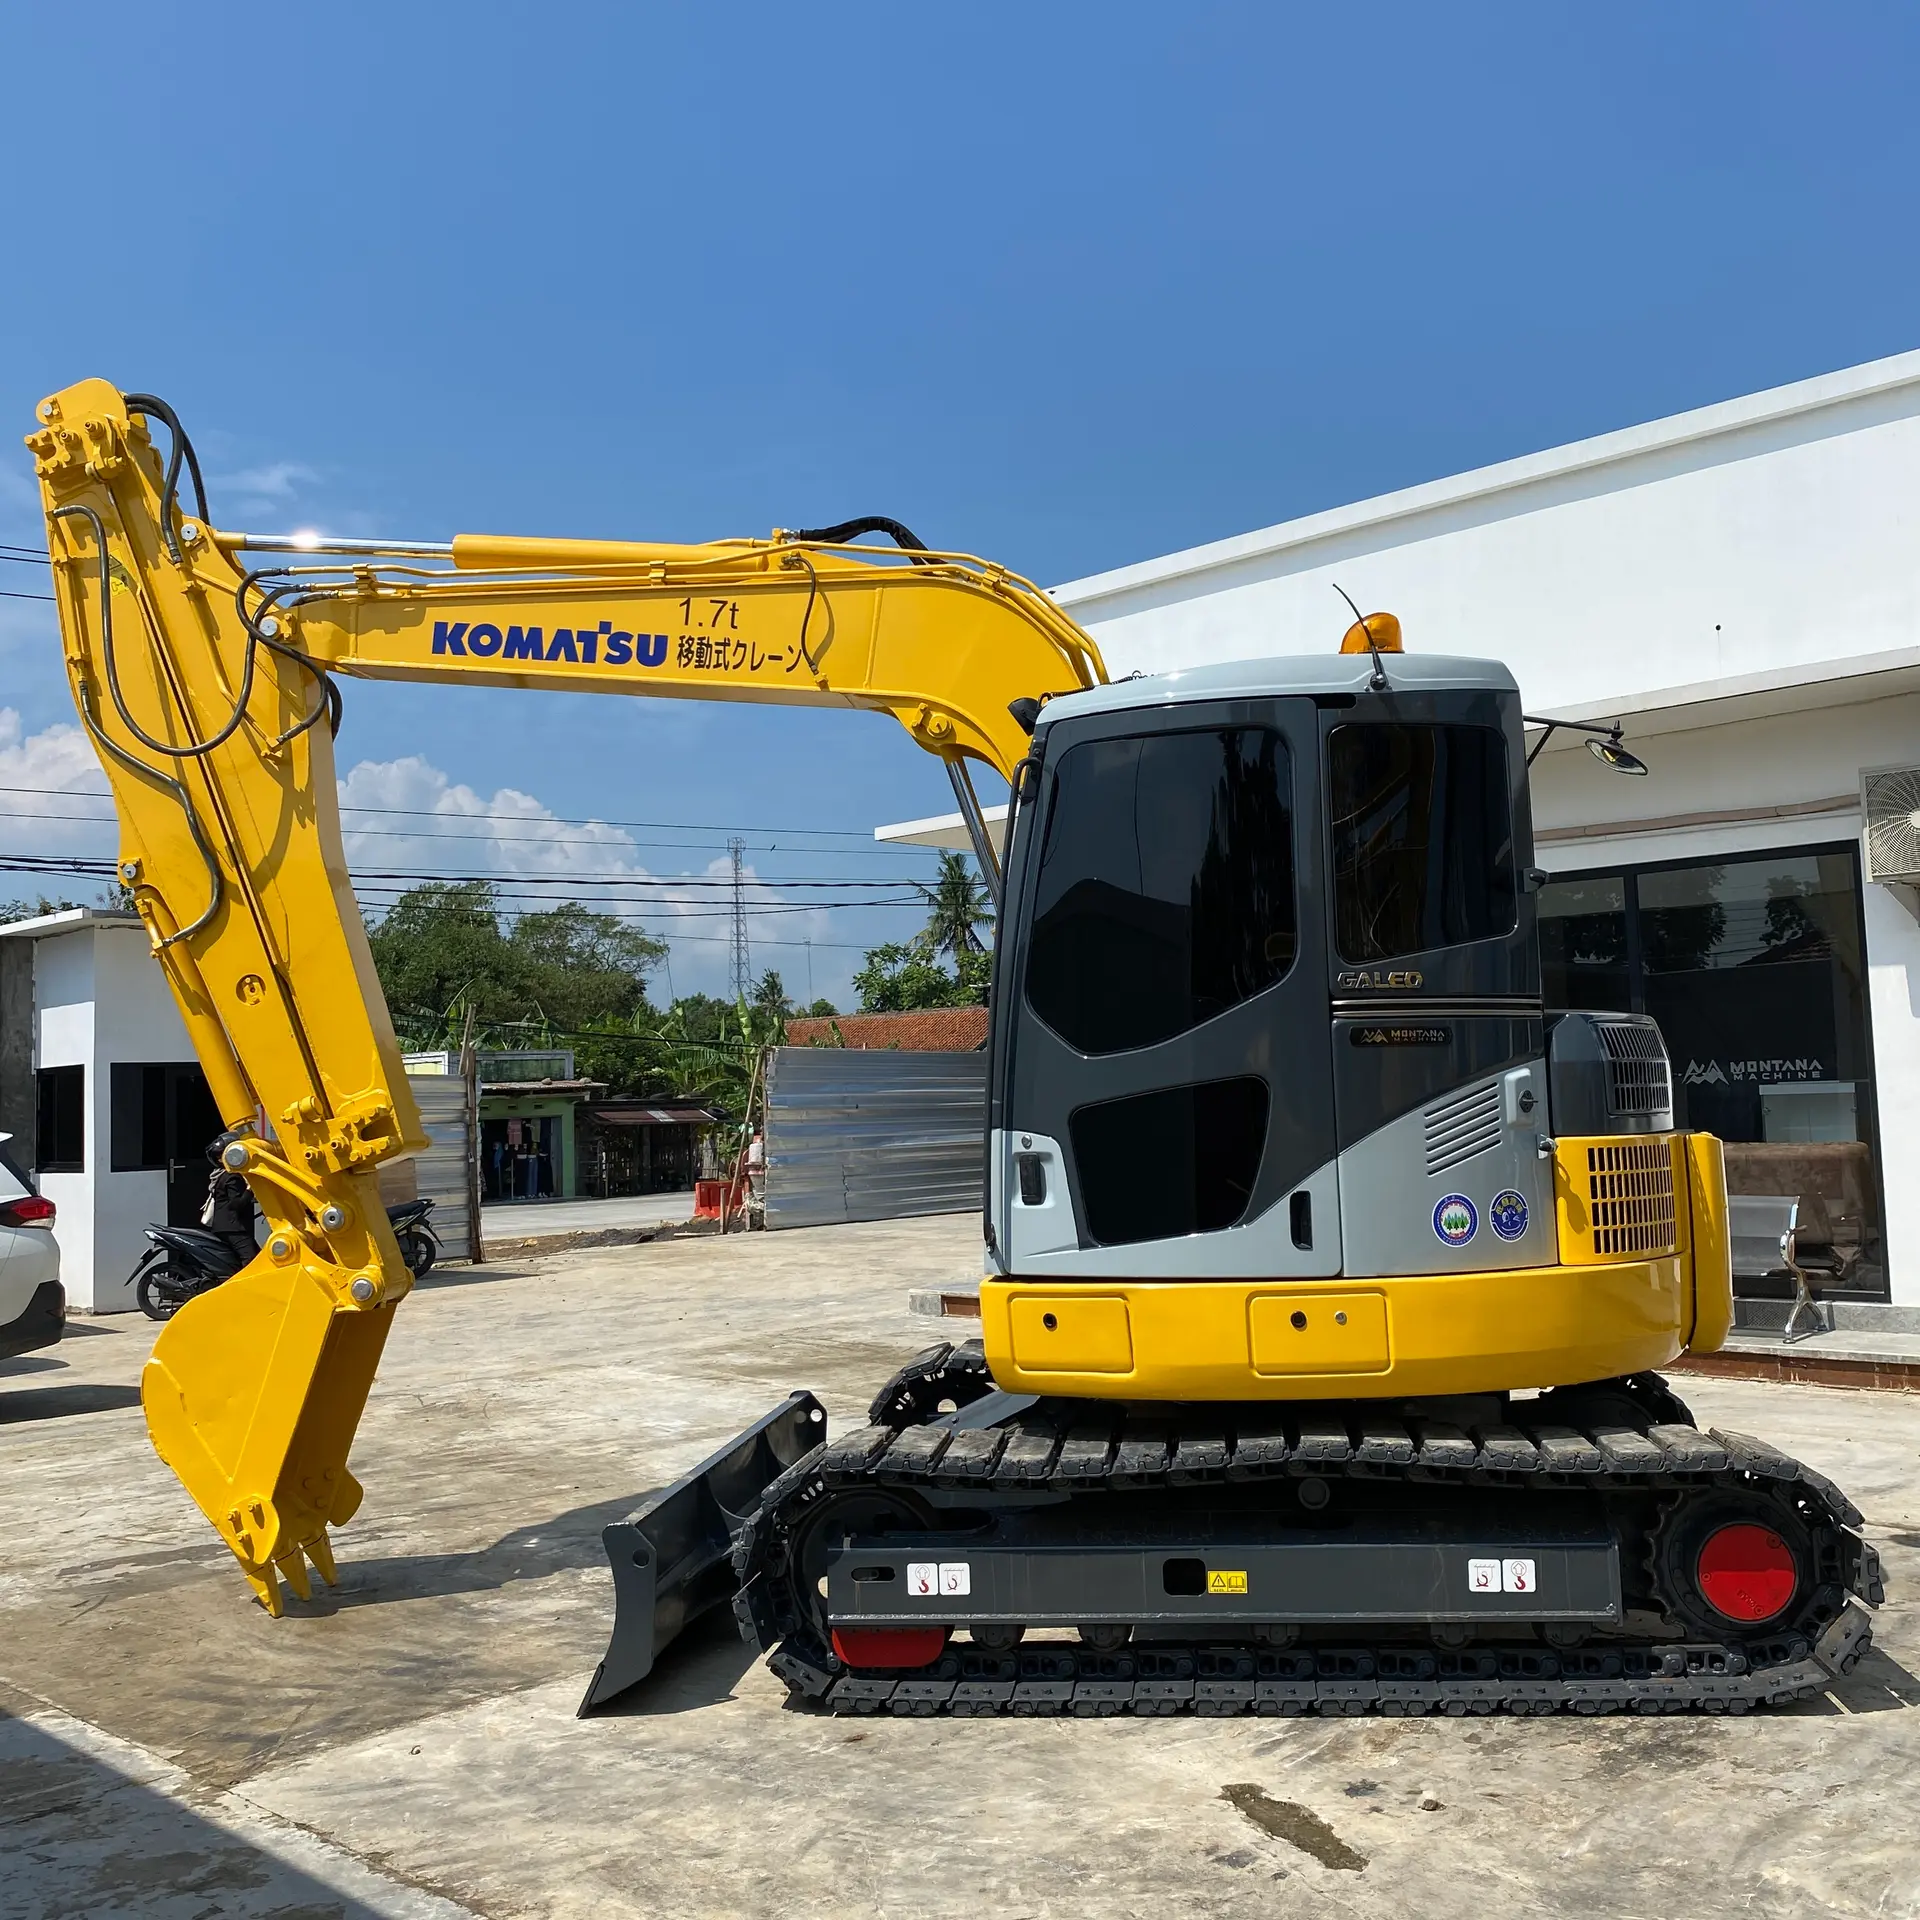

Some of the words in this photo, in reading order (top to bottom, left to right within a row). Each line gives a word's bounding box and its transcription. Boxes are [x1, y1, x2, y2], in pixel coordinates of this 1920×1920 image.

[678, 597, 740, 629] 1.7t
[432, 620, 668, 667] KOMATSU
[676, 634, 802, 673] 移動式クレーン
[1337, 971, 1424, 989] GALEO
[1391, 1029, 1445, 1037] MONTANA
[1730, 1059, 1824, 1074] MONTANA
[1733, 1071, 1821, 1081] MACHINE
